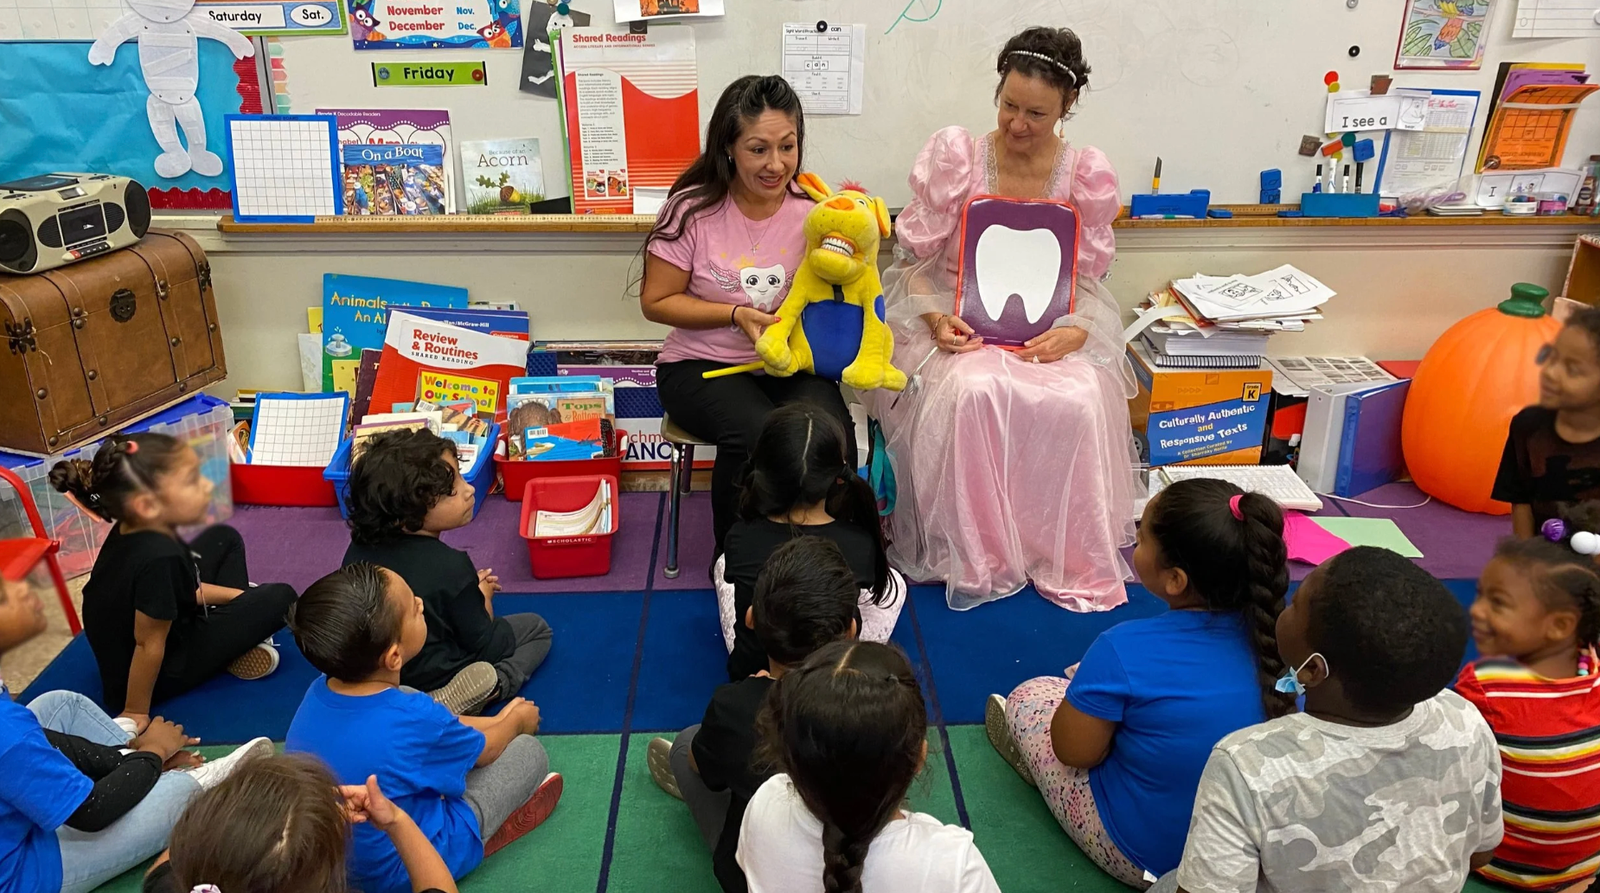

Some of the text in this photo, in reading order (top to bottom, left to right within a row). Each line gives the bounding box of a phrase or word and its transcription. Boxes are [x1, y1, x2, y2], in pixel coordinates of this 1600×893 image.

[302, 9, 324, 20] Sat.
[387, 4, 443, 16] November
[456, 6, 475, 15] Nov.
[208, 10, 262, 24] Saturday
[389, 20, 445, 31] December
[457, 22, 477, 30] Dec.
[572, 33, 646, 43] Shared Readings
[404, 67, 454, 81] Friday
[1342, 116, 1387, 128] I see a
[362, 146, 424, 160] On a Boat
[477, 154, 528, 168] Acorn
[1488, 186, 1497, 197] I
[330, 292, 387, 309] Animals
[354, 310, 370, 322] An
[413, 329, 458, 345] Review
[412, 341, 478, 360] & Routines
[411, 351, 474, 365] SHARED READING
[424, 375, 495, 396] Welcome to
[425, 390, 447, 401] Our
[1248, 390, 1256, 399] K
[1159, 405, 1256, 428] Culturally Authentic
[1198, 423, 1214, 432] and
[1160, 423, 1248, 449] Responsive Texts
[1182, 446, 1205, 455] Collection
